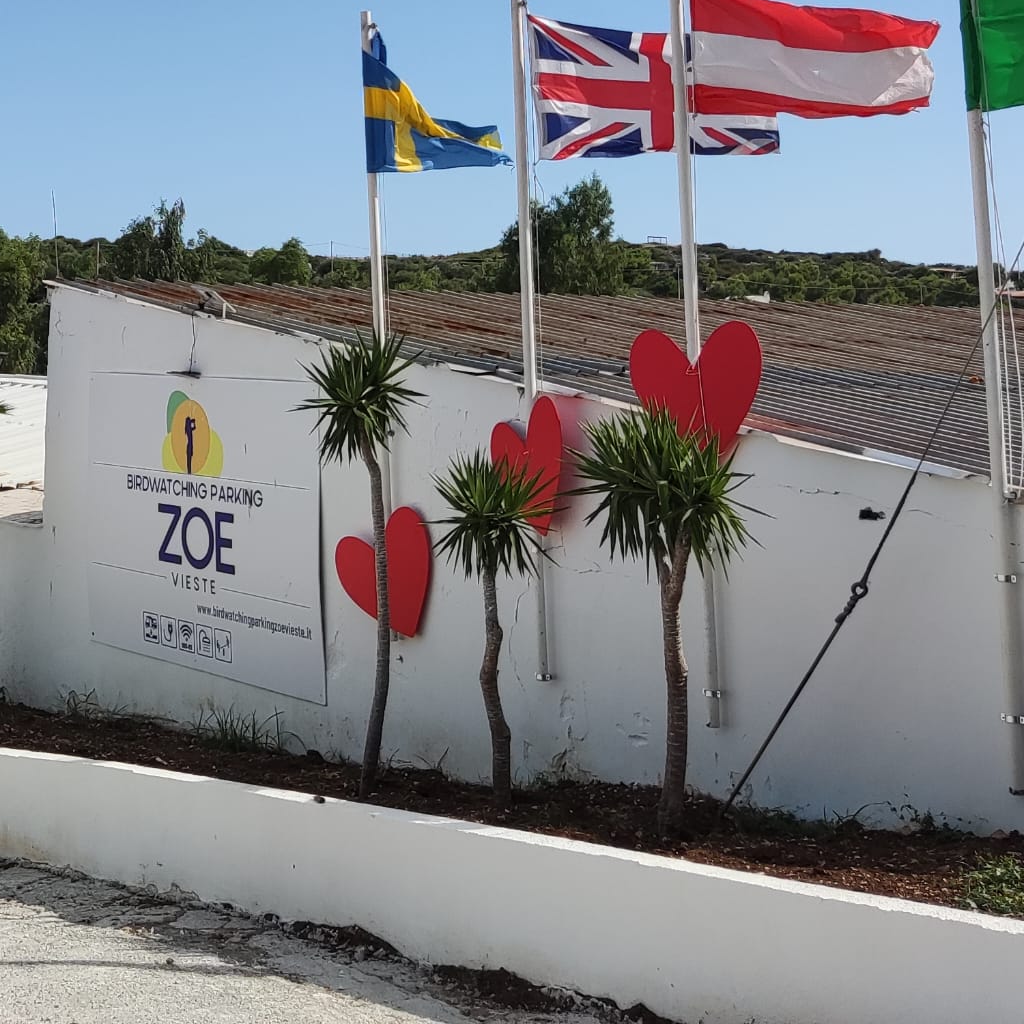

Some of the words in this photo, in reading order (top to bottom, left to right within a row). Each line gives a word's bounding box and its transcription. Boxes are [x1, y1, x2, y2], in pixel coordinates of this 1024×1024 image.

[127, 474, 207, 499] BIRDWATCHING
[210, 484, 263, 507] PARKING
[158, 503, 235, 575] ZOE
[171, 572, 216, 594] VIESTE
[197, 604, 312, 640] www.birdwatchingparkingzoevieste.it
